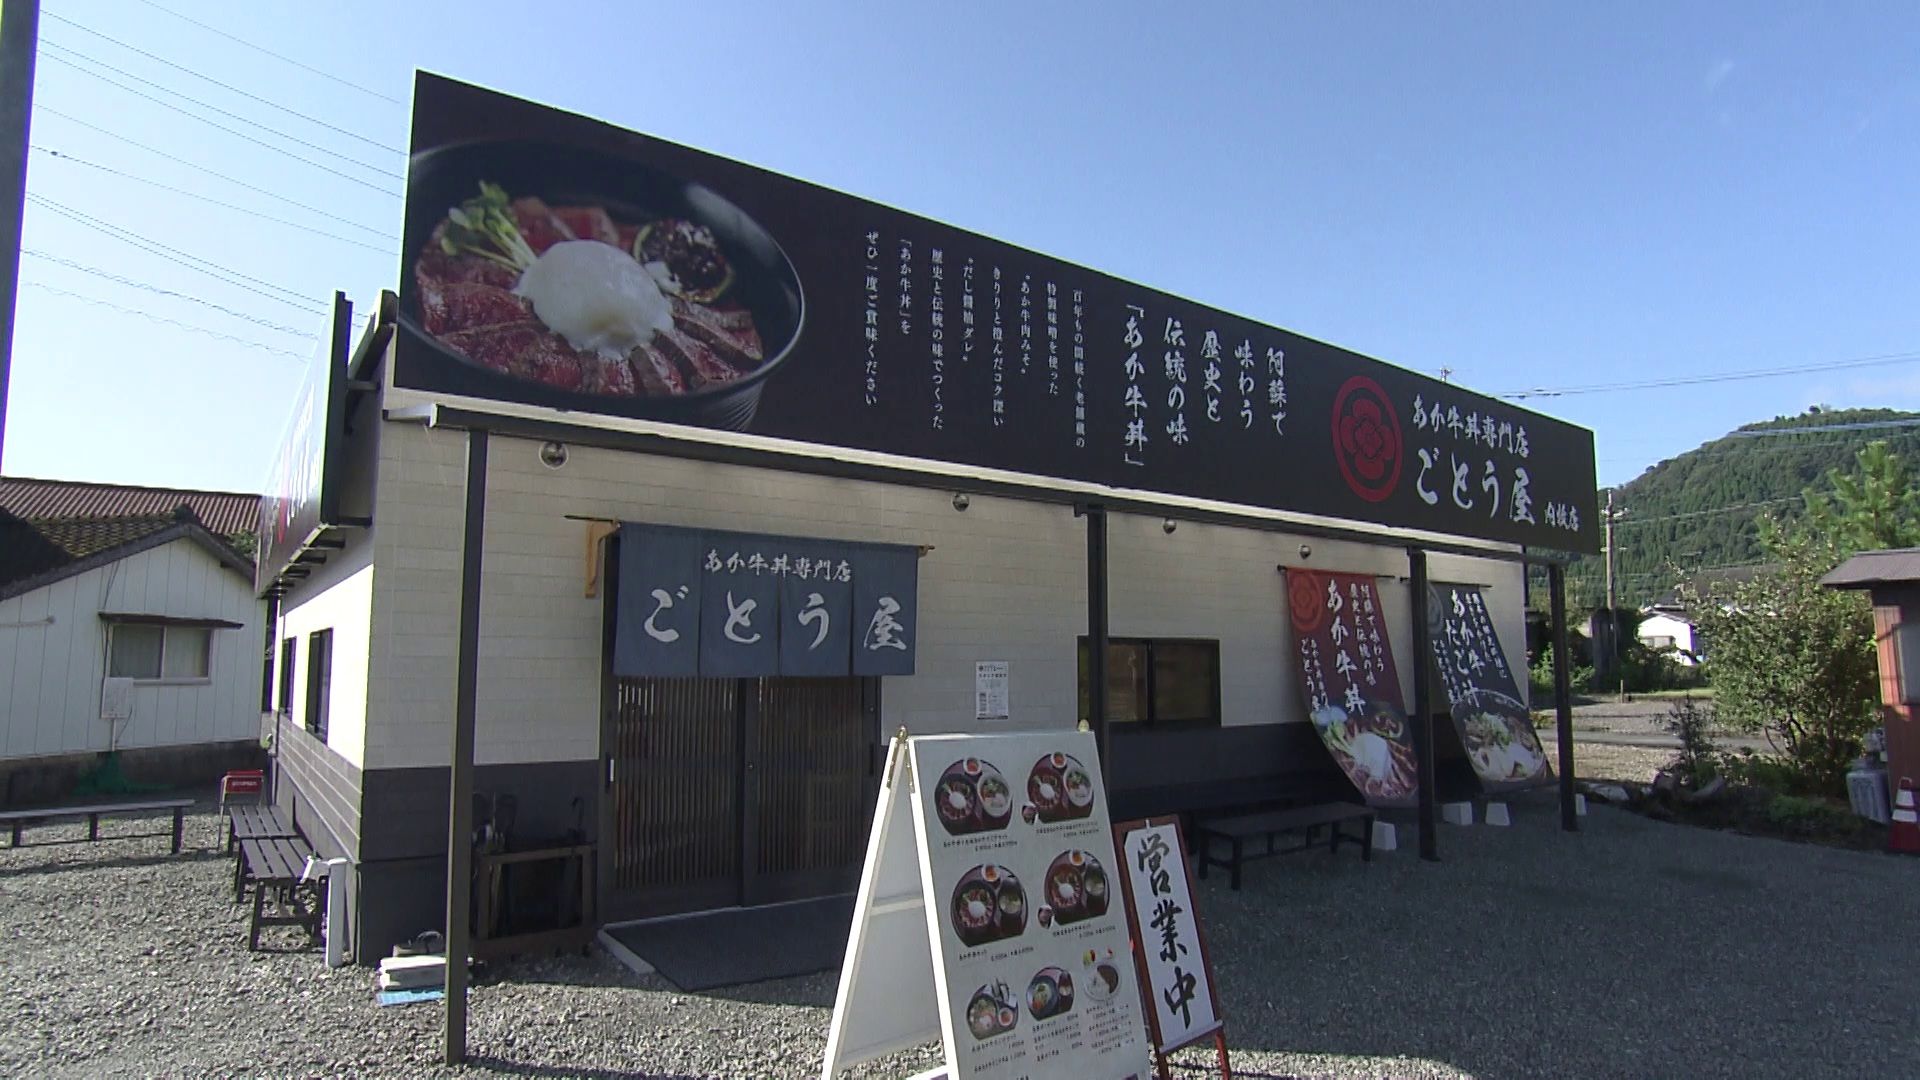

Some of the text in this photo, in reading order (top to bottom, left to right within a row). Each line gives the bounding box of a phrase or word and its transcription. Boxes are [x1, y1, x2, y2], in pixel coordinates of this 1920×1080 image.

[865, 231, 878, 405] ぜひ一度ご賞味ください
[899, 239, 912, 335] 「あか牛丼」を
[1164, 317, 1189, 445] 伝統の味
[1200, 330, 1222, 423] 歴史と
[1234, 339, 1255, 429] 味わう
[1412, 393, 1530, 459] あか牛丼専門店
[1416, 447, 1536, 525] ごとう屋
[704, 549, 852, 582] あか牛丼専門店
[643, 585, 908, 651] ごとう屋
[1327, 579, 1367, 716] あか牛丼
[1137, 832, 1197, 1031] 営業中
